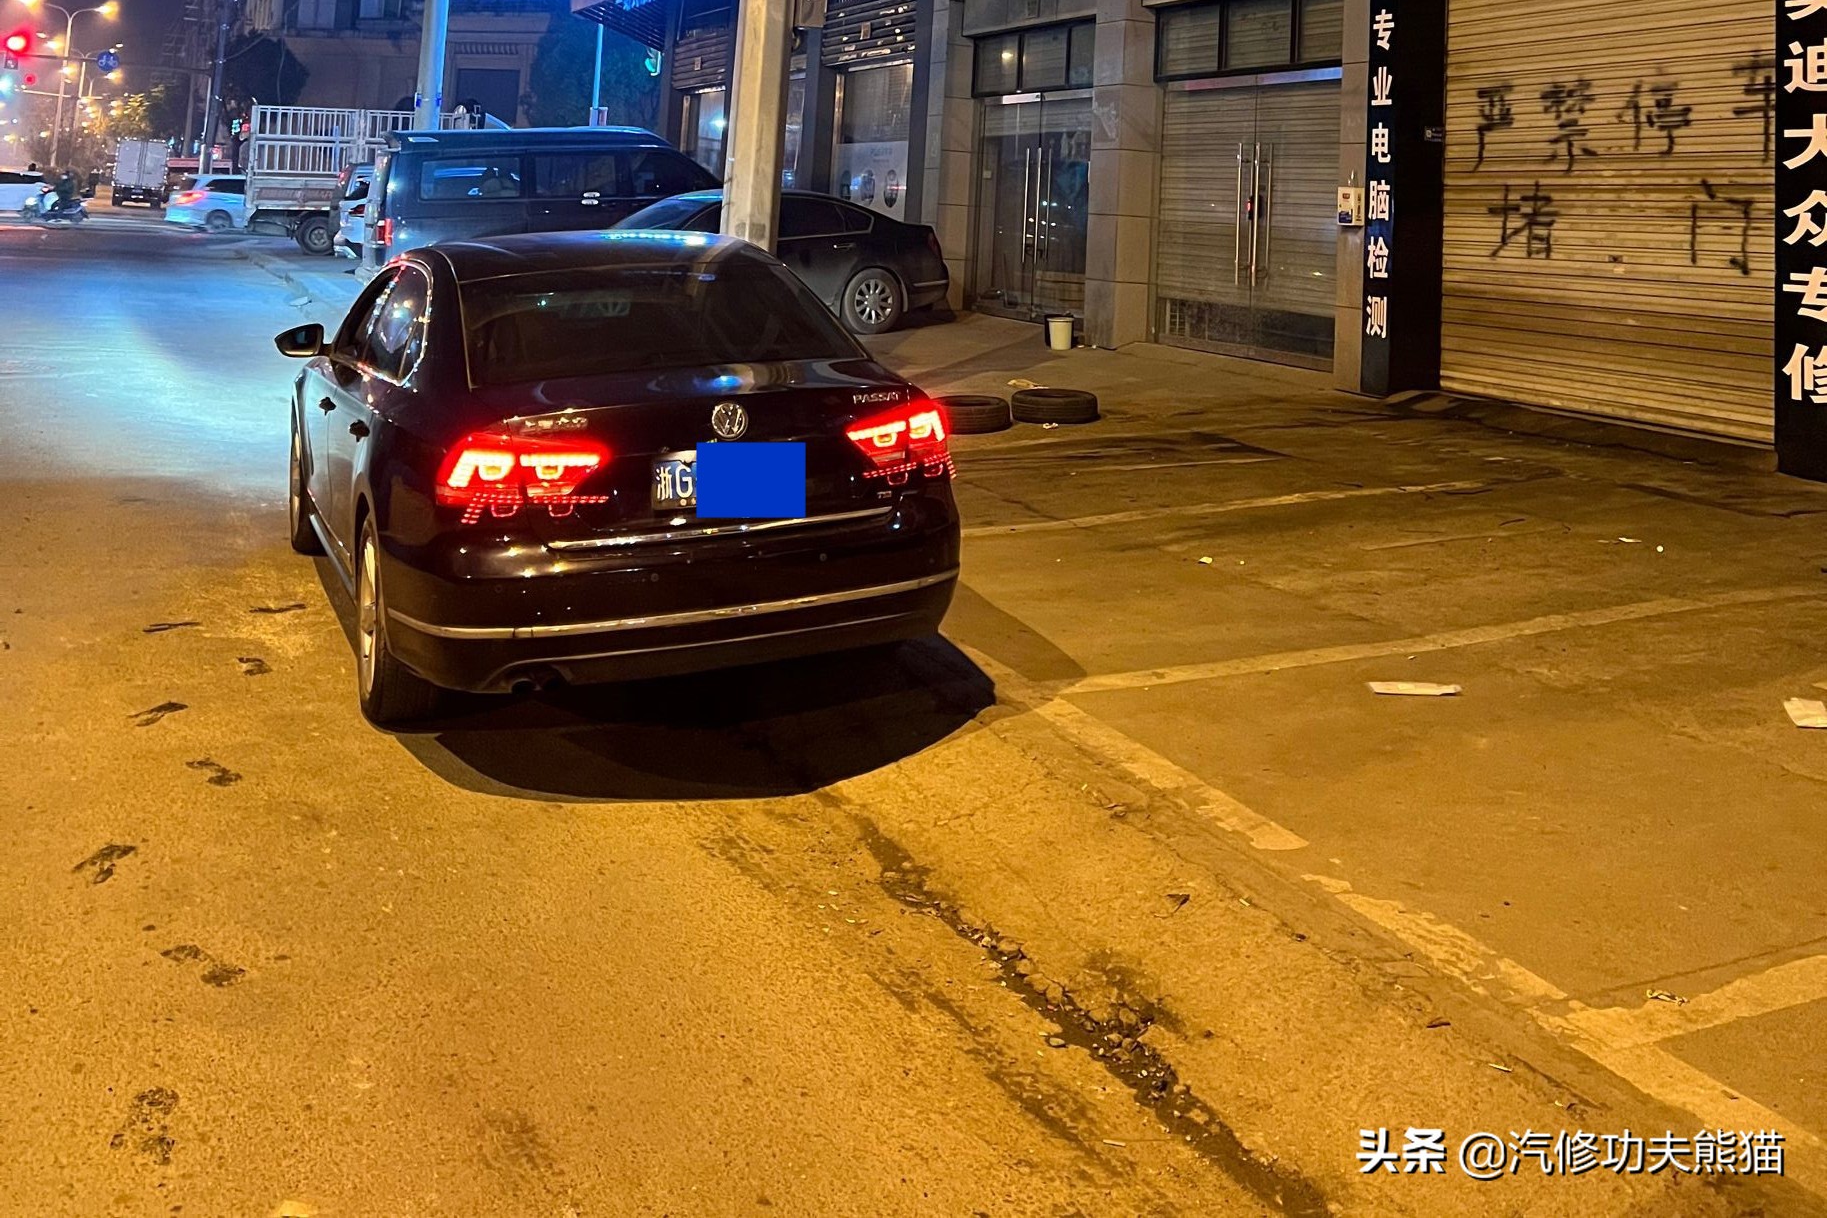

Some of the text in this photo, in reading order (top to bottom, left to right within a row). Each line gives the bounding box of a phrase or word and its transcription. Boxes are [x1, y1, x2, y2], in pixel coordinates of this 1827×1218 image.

[1365, 8, 1395, 339] 专业电脑检测
